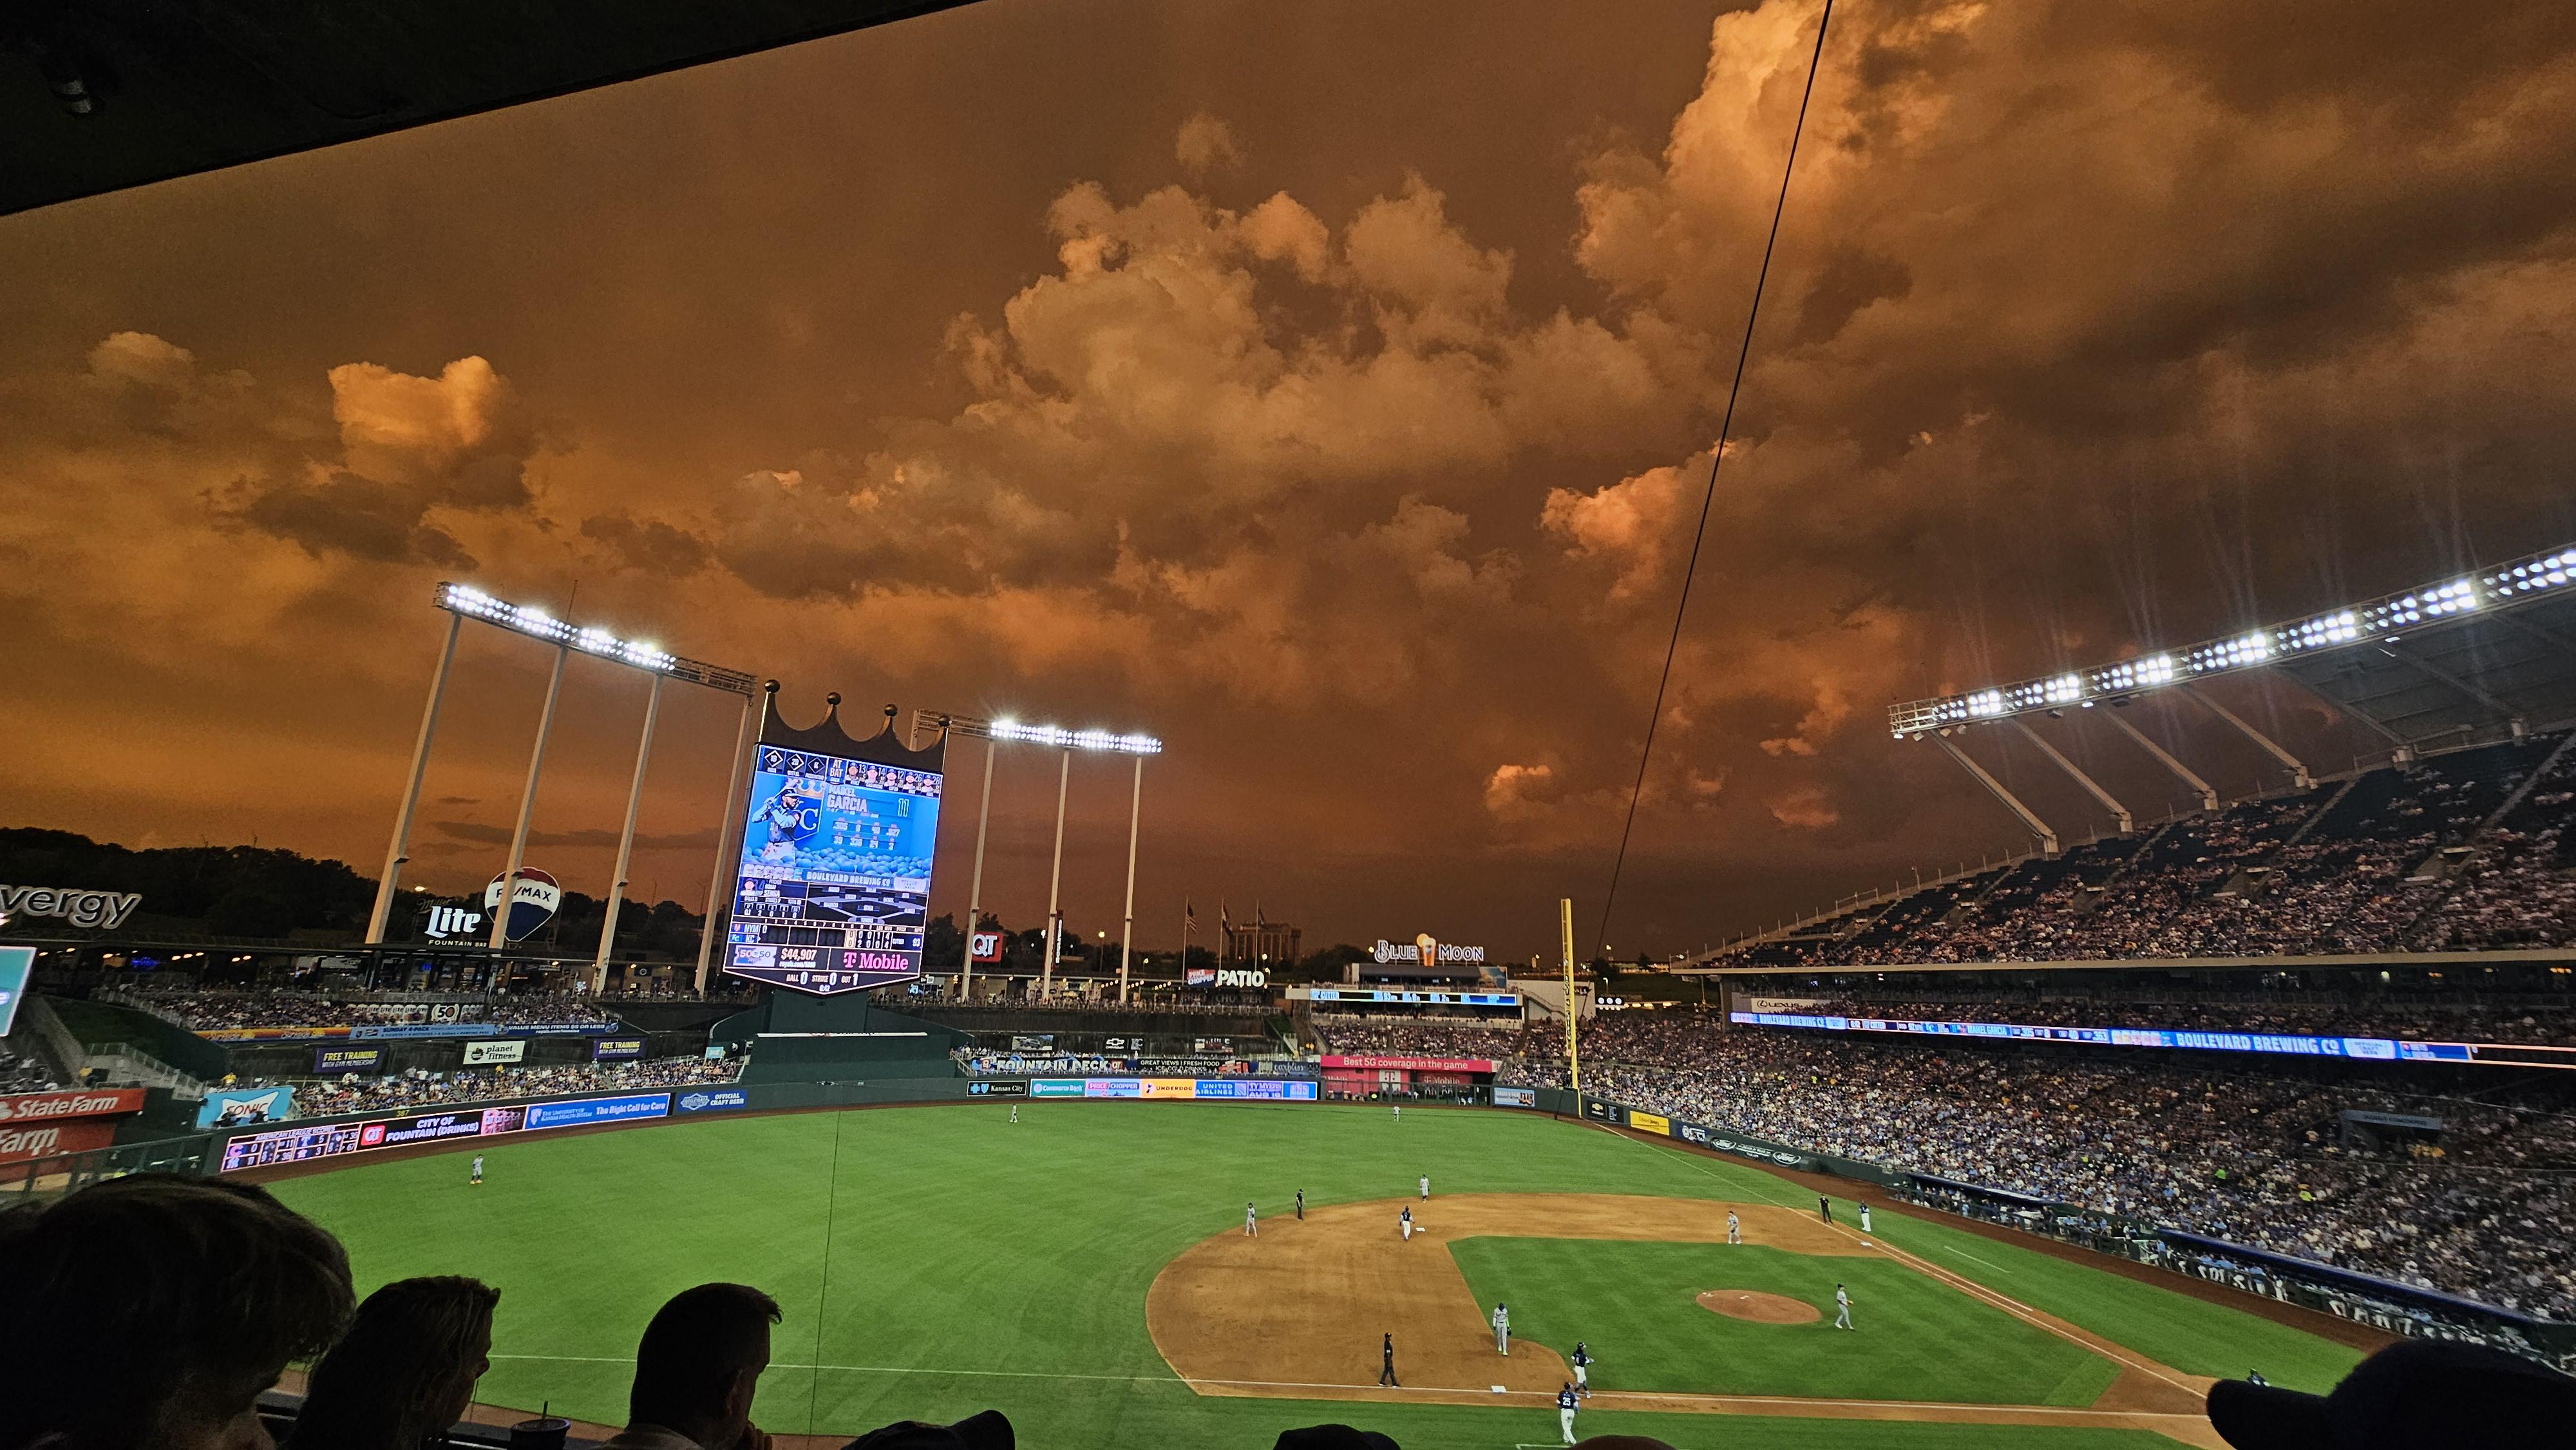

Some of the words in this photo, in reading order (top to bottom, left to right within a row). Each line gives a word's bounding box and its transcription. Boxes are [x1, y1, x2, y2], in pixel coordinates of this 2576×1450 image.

[833, 759, 842, 768] AT
[858, 764, 866, 773] 13
[830, 767, 843, 778] BAT
[878, 767, 886, 777] 14
[897, 770, 905, 779] 12
[914, 773, 922, 782] 26
[932, 777, 940, 785] 28
[828, 786, 856, 797] MAIKEL
[826, 794, 867, 812] GARCIA
[898, 798, 909, 817] 11
[807, 871, 849, 883] BOULEVARD
[850, 875, 881, 886] BREWING
[424, 906, 481, 938] Lite
[744, 925, 759, 933] NYM
[746, 934, 755, 943] KC
[913, 938, 920, 946] 93
[972, 934, 998, 957] QT
[1374, 939, 1418, 963] BLUE
[1439, 943, 1484, 961] MOON
[781, 948, 817, 961] $44,907
[858, 953, 908, 970] Mobile
[800, 971, 808, 984] 0
[829, 972, 837, 985] 0
[853, 973, 858, 986] 1
[1189, 969, 1206, 977] PRICE
[1188, 974, 1215, 985] CHOPPER
[1217, 970, 1265, 988] PATIO
[1759, 1015, 1790, 1026] BOULEVARD
[1791, 1015, 1817, 1027] BREWING
[1967, 1025, 1987, 1034] MAIKEL
[1987, 1026, 2007, 1035] GARCIA
[2068, 1030, 2079, 1040] 40
[2093, 1031, 2107, 1040] .363
[2176, 1033, 2251, 1050] BOULEVARD
[2253, 1036, 2318, 1053] BREWING
[323, 1052, 343, 1061] FREE
[344, 1051, 377, 1060] TRAINING
[486, 1046, 513, 1055] planet
[998, 1060, 1068, 1071] FOUNTAIN
[1072, 1060, 1109, 1071] DECK
[1344, 1058, 1363, 1066] Best
[1364, 1058, 1376, 1066] 5G
[1378, 1060, 1417, 1069] coverage
[1444, 1062, 1468, 1070] game
[596, 1107, 609, 1115] The
[609, 1105, 627, 1115] Right
[627, 1104, 640, 1113] Call
[650, 1102, 665, 1110] Care
[417, 1117, 439, 1129] CITY
[440, 1116, 455, 1125] OF
[365, 1127, 381, 1142] QT
[386, 1127, 436, 1142] FOUNTAIN
[437, 1122, 478, 1137] (DRINKS)
[319, 1135, 325, 1144] 5
[251, 1144, 257, 1153] 0
[315, 1146, 321, 1156] 3
